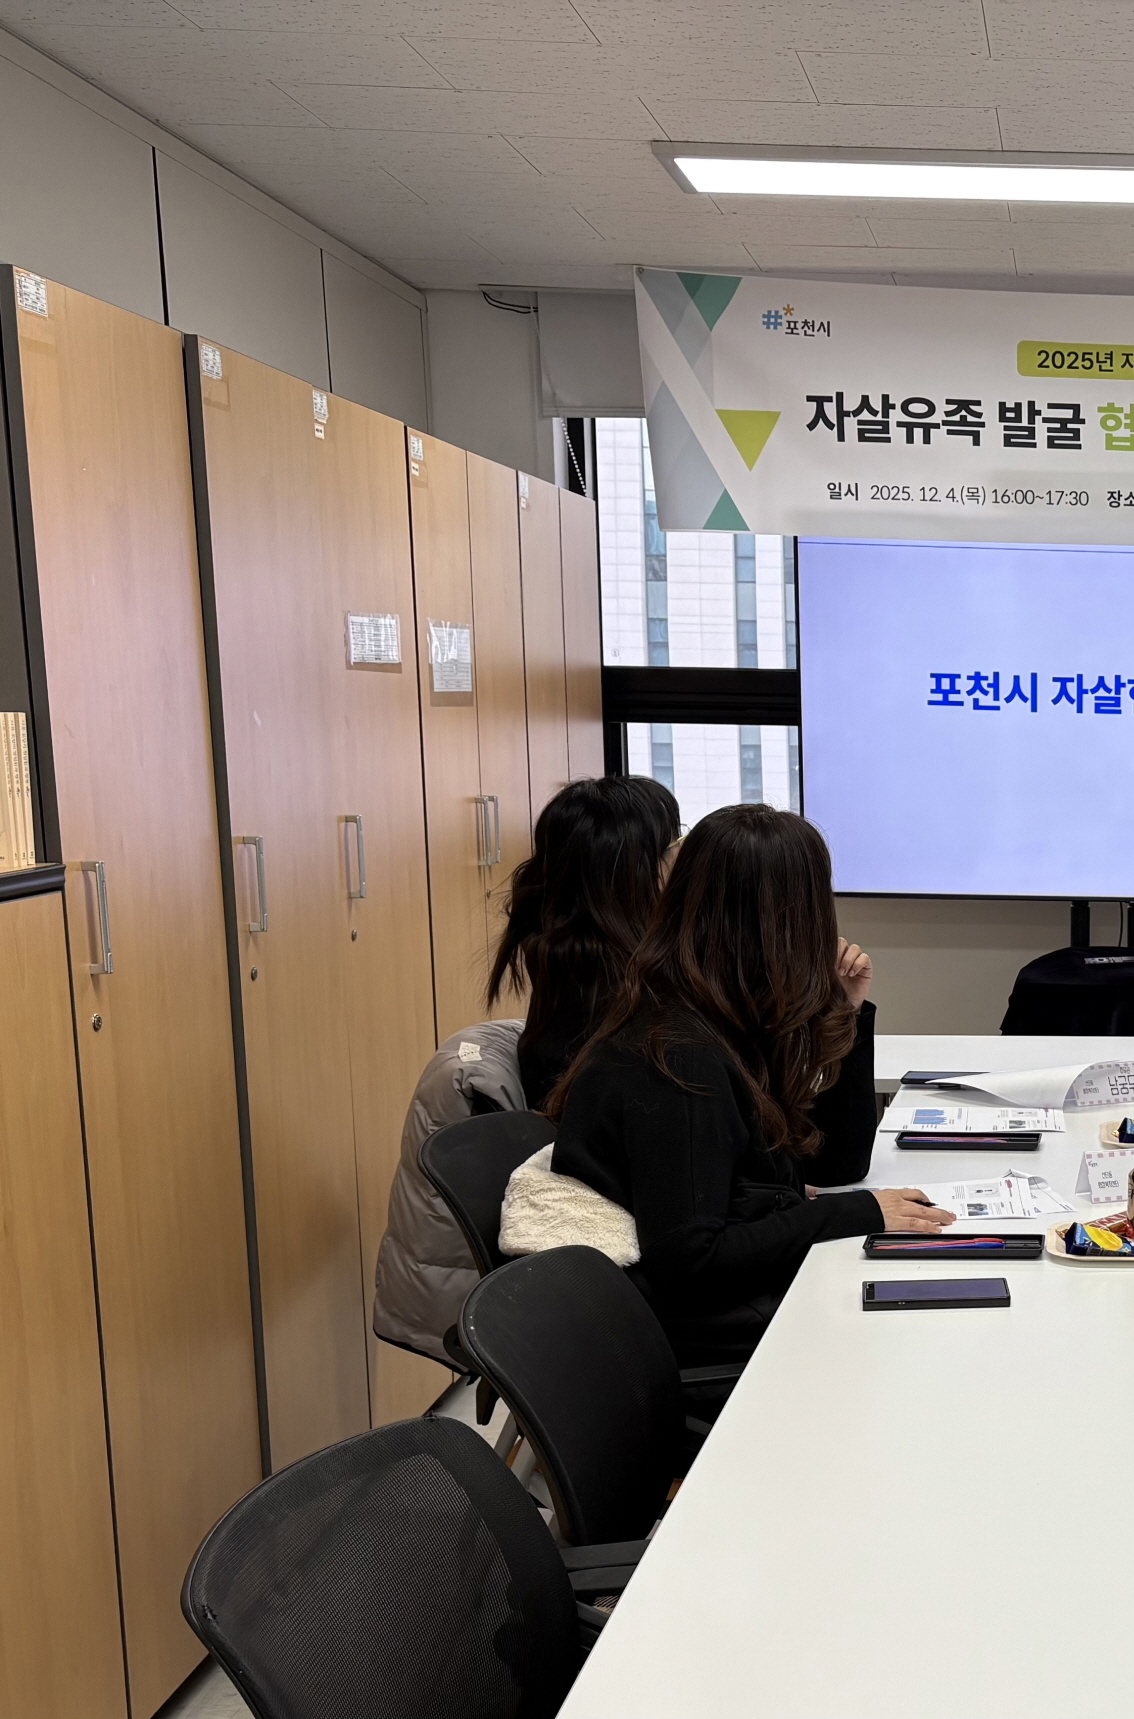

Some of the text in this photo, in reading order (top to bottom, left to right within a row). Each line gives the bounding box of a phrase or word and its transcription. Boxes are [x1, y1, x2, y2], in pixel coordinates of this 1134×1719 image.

[1036, 349, 1115, 373] 2025년
[805, 391, 986, 447] 자살유족
[998, 400, 1086, 450] 발굴
[826, 481, 859, 501] 일시
[870, 484, 914, 502] 2025.
[991, 488, 1090, 507] 16:00~17:30
[927, 671, 1038, 713] 포천시
